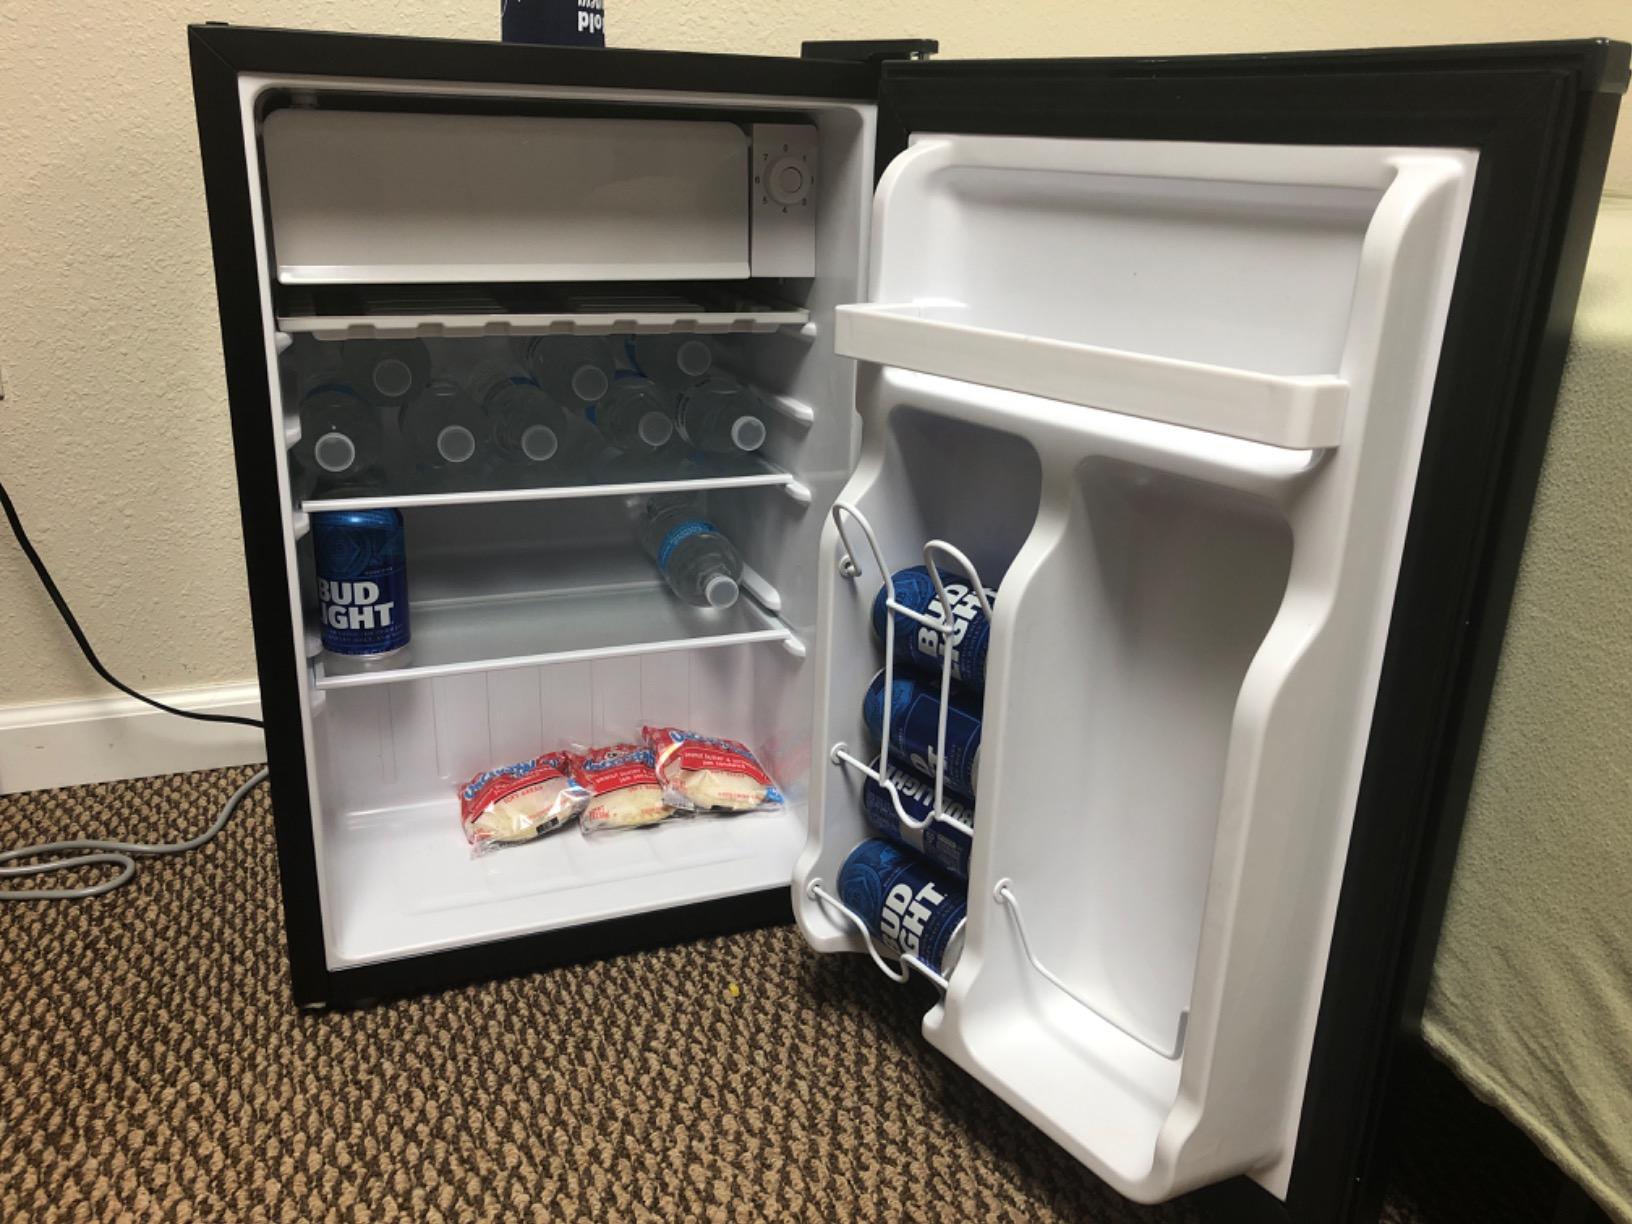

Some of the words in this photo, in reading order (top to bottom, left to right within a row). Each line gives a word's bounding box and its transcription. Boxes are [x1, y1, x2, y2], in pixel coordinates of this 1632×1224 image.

[318, 577, 380, 605] BUD
[320, 601, 394, 630] IGHT
[899, 881, 945, 958] GHT
